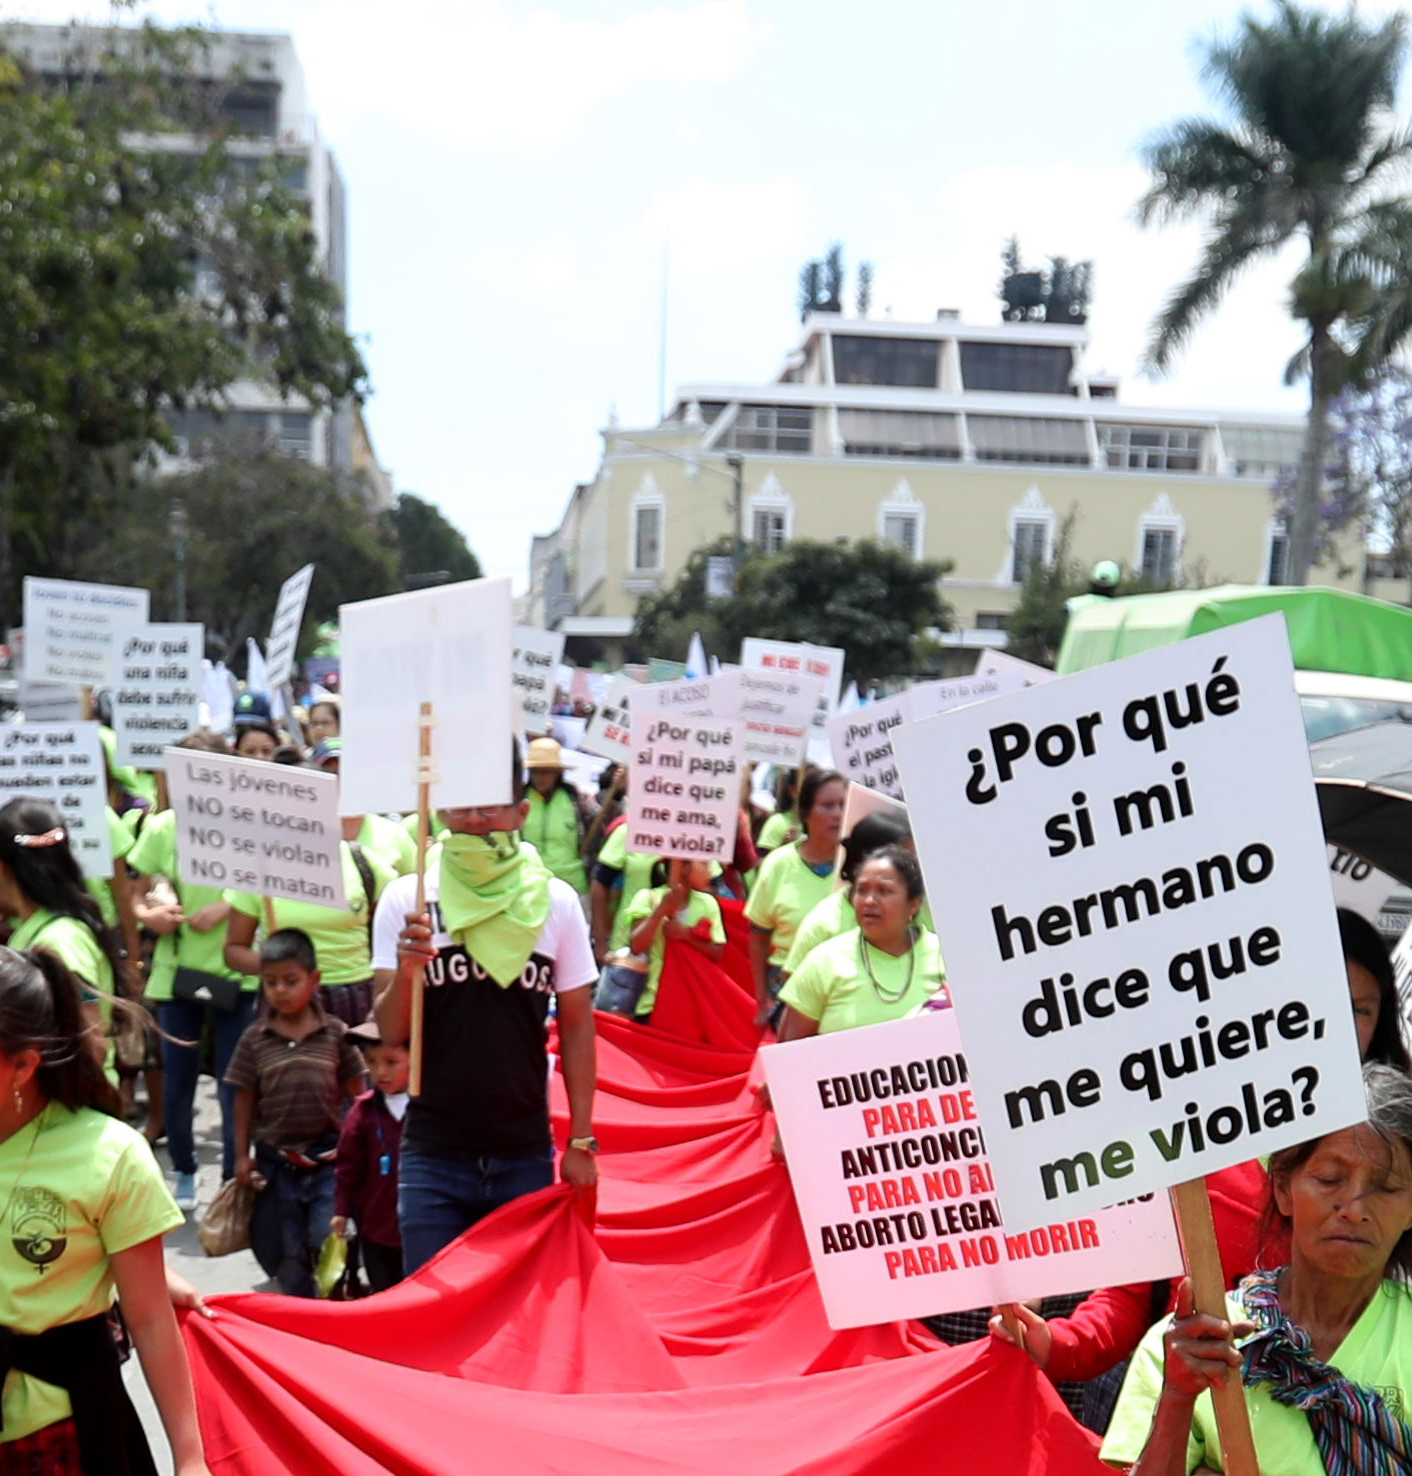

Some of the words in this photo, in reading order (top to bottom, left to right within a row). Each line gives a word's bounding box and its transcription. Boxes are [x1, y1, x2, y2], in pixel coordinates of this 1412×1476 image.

[123, 635, 155, 658] ¿Por
[161, 636, 188, 658] qué
[525, 651, 553, 669] qué
[125, 666, 151, 679] una
[156, 662, 188, 679] niña
[117, 688, 151, 704] debe
[156, 688, 196, 705] sufrir
[941, 686, 957, 698] En
[959, 683, 970, 696] la
[973, 680, 999, 694] calle
[125, 712, 189, 730] violencia
[647, 721, 690, 742] ¿Por
[696, 728, 733, 748] qué
[844, 722, 873, 748] ¿Por
[965, 709, 1101, 805] ¿Por
[1122, 655, 1241, 754] qué
[44, 730, 75, 747] qué
[21, 752, 64, 766] niñas
[69, 754, 89, 766] no
[637, 747, 655, 765] si
[658, 750, 683, 769] mi
[689, 755, 737, 776] papá
[849, 754, 861, 767] el
[58, 774, 97, 787] estar
[186, 762, 223, 785] Las
[229, 767, 319, 802] jóvenes
[644, 775, 684, 796] dice
[689, 784, 726, 803] que
[187, 795, 223, 816] NO
[230, 805, 254, 821] se
[261, 807, 325, 835] tocan
[640, 806, 670, 822] me
[1044, 790, 1096, 858] si
[1113, 761, 1194, 837] mi
[189, 826, 225, 848] NO
[232, 836, 255, 853] se
[262, 839, 330, 867] violan
[634, 832, 664, 847] me
[669, 836, 725, 854] viola?
[190, 858, 227, 880] NO
[233, 867, 258, 884] se
[263, 873, 335, 900] matan
[990, 841, 1275, 961] hermano
[1021, 967, 1150, 1039] dice
[1168, 926, 1282, 1002] que
[1003, 1068, 1101, 1129] me
[1119, 998, 1327, 1102] quiere,
[862, 1099, 932, 1138] PARA
[940, 1090, 977, 1123] DE
[1039, 1139, 1134, 1201] me
[1148, 1064, 1320, 1162] viola?
[841, 1126, 986, 1179] ANTICONC
[847, 1175, 920, 1214] PARA
[924, 1167, 962, 1201] NO
[968, 1162, 995, 1194] A
[820, 1211, 928, 1254] ABORTO
[933, 1197, 1003, 1236] LEGA
[884, 1242, 958, 1280] PARA
[960, 1233, 999, 1268] NO
[1003, 1219, 1100, 1261] MORIR
